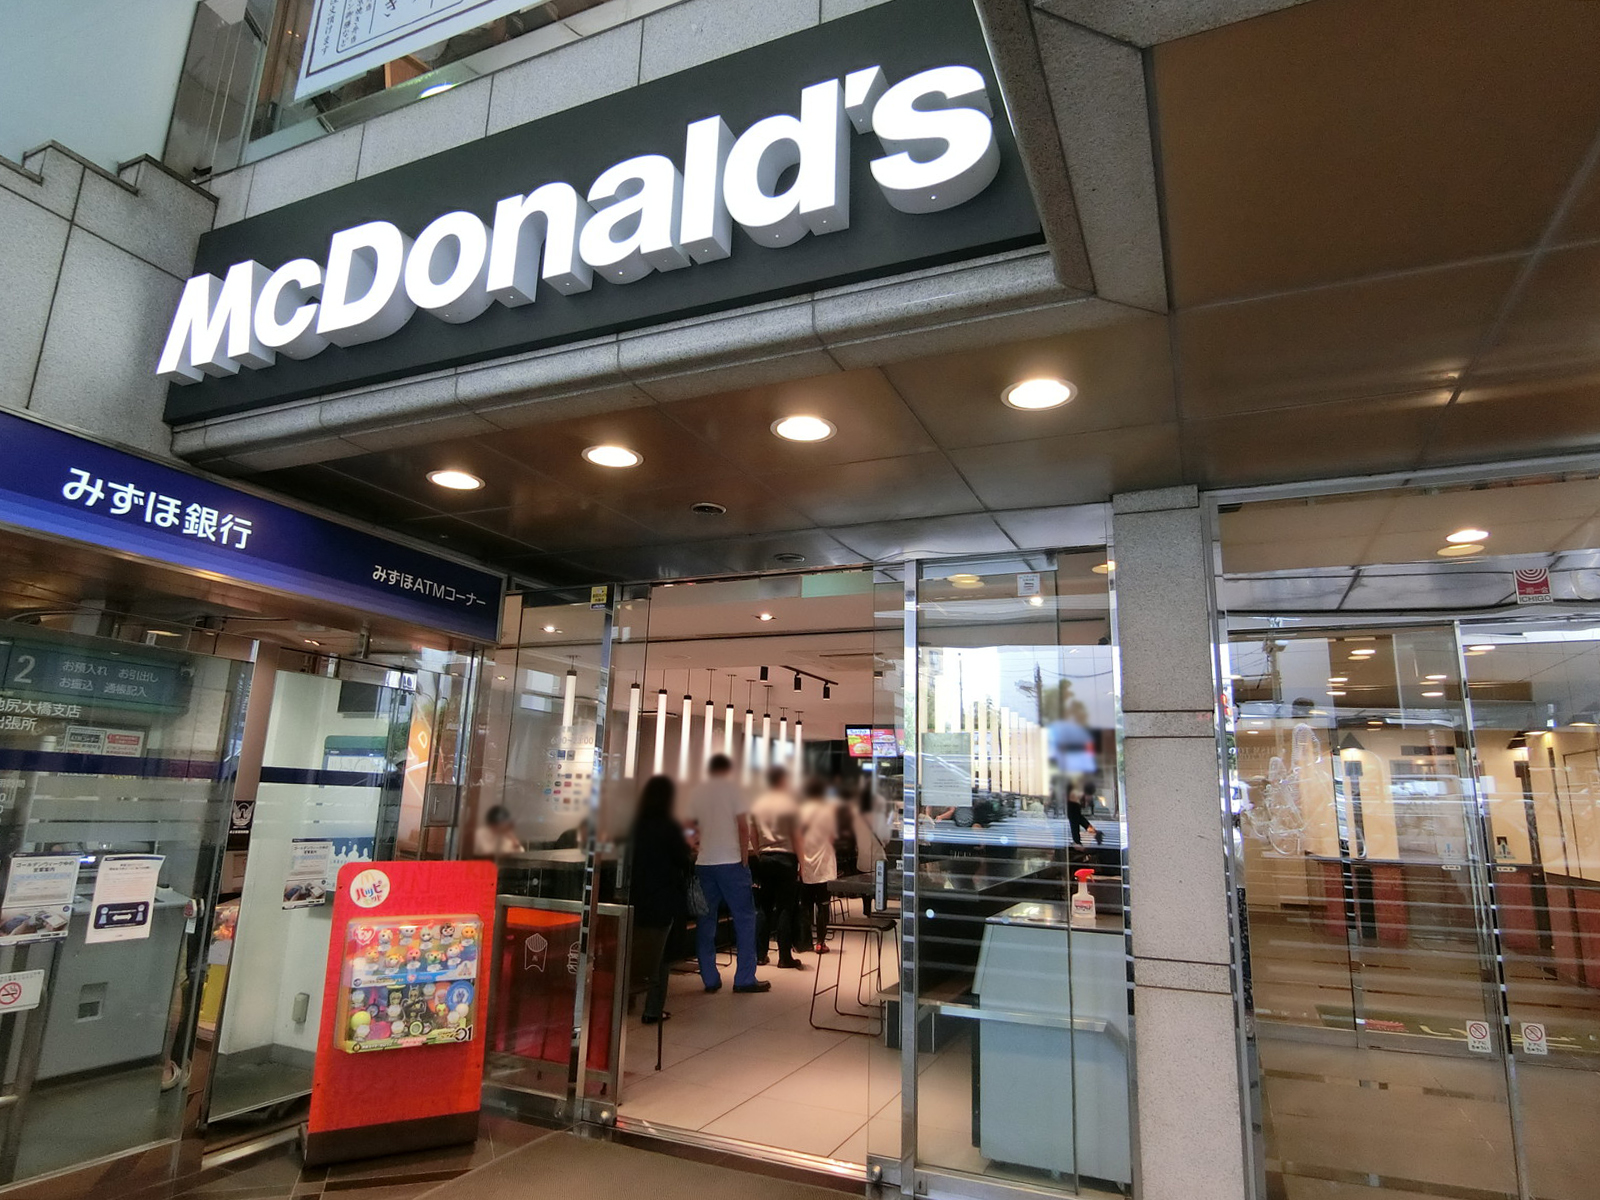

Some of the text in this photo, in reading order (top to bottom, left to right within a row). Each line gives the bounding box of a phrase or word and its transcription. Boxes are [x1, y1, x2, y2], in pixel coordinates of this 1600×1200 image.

[156, 65, 998, 379] McDonald's
[62, 467, 252, 549] みずほ銀行
[372, 564, 486, 606] みずほATMコーナー
[1519, 594, 1551, 603] ICHIGO
[14, 655, 36, 684] 2
[62, 661, 159, 683] お預入れ お引出し
